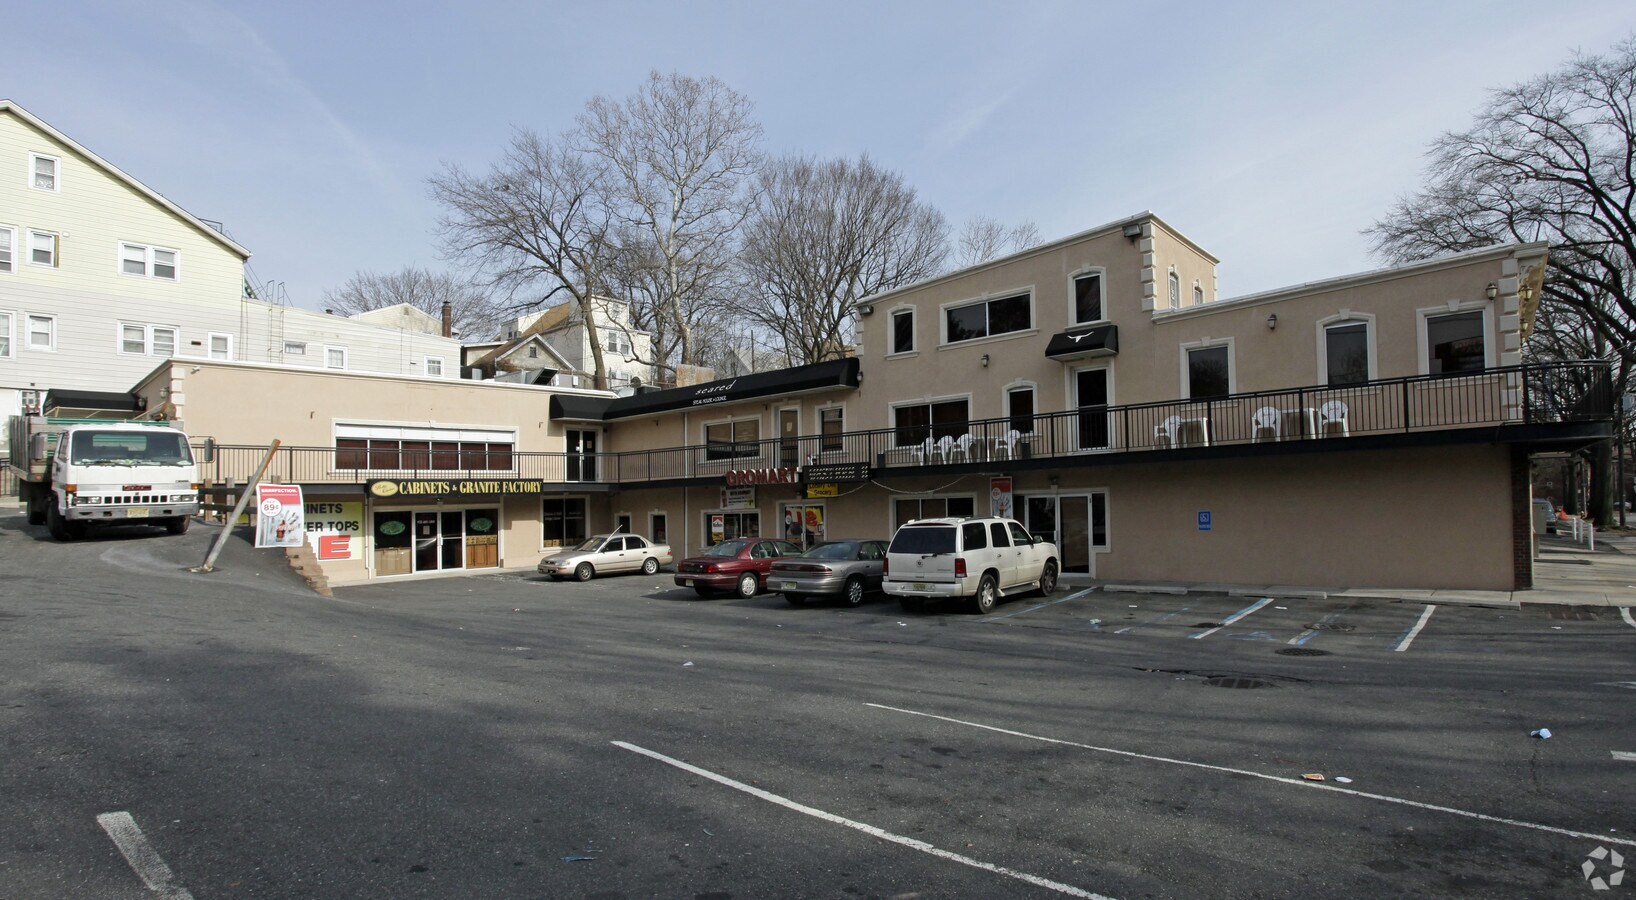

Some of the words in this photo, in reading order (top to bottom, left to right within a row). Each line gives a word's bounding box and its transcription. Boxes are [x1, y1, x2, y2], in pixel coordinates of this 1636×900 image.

[695, 380, 737, 395] seared
[399, 481, 450, 494] CABINETS
[460, 481, 500, 494] GRANITE
[502, 481, 542, 493] FACTORY
[304, 503, 343, 514] INETS
[304, 521, 323, 532] ER
[328, 521, 359, 531] TOPS
